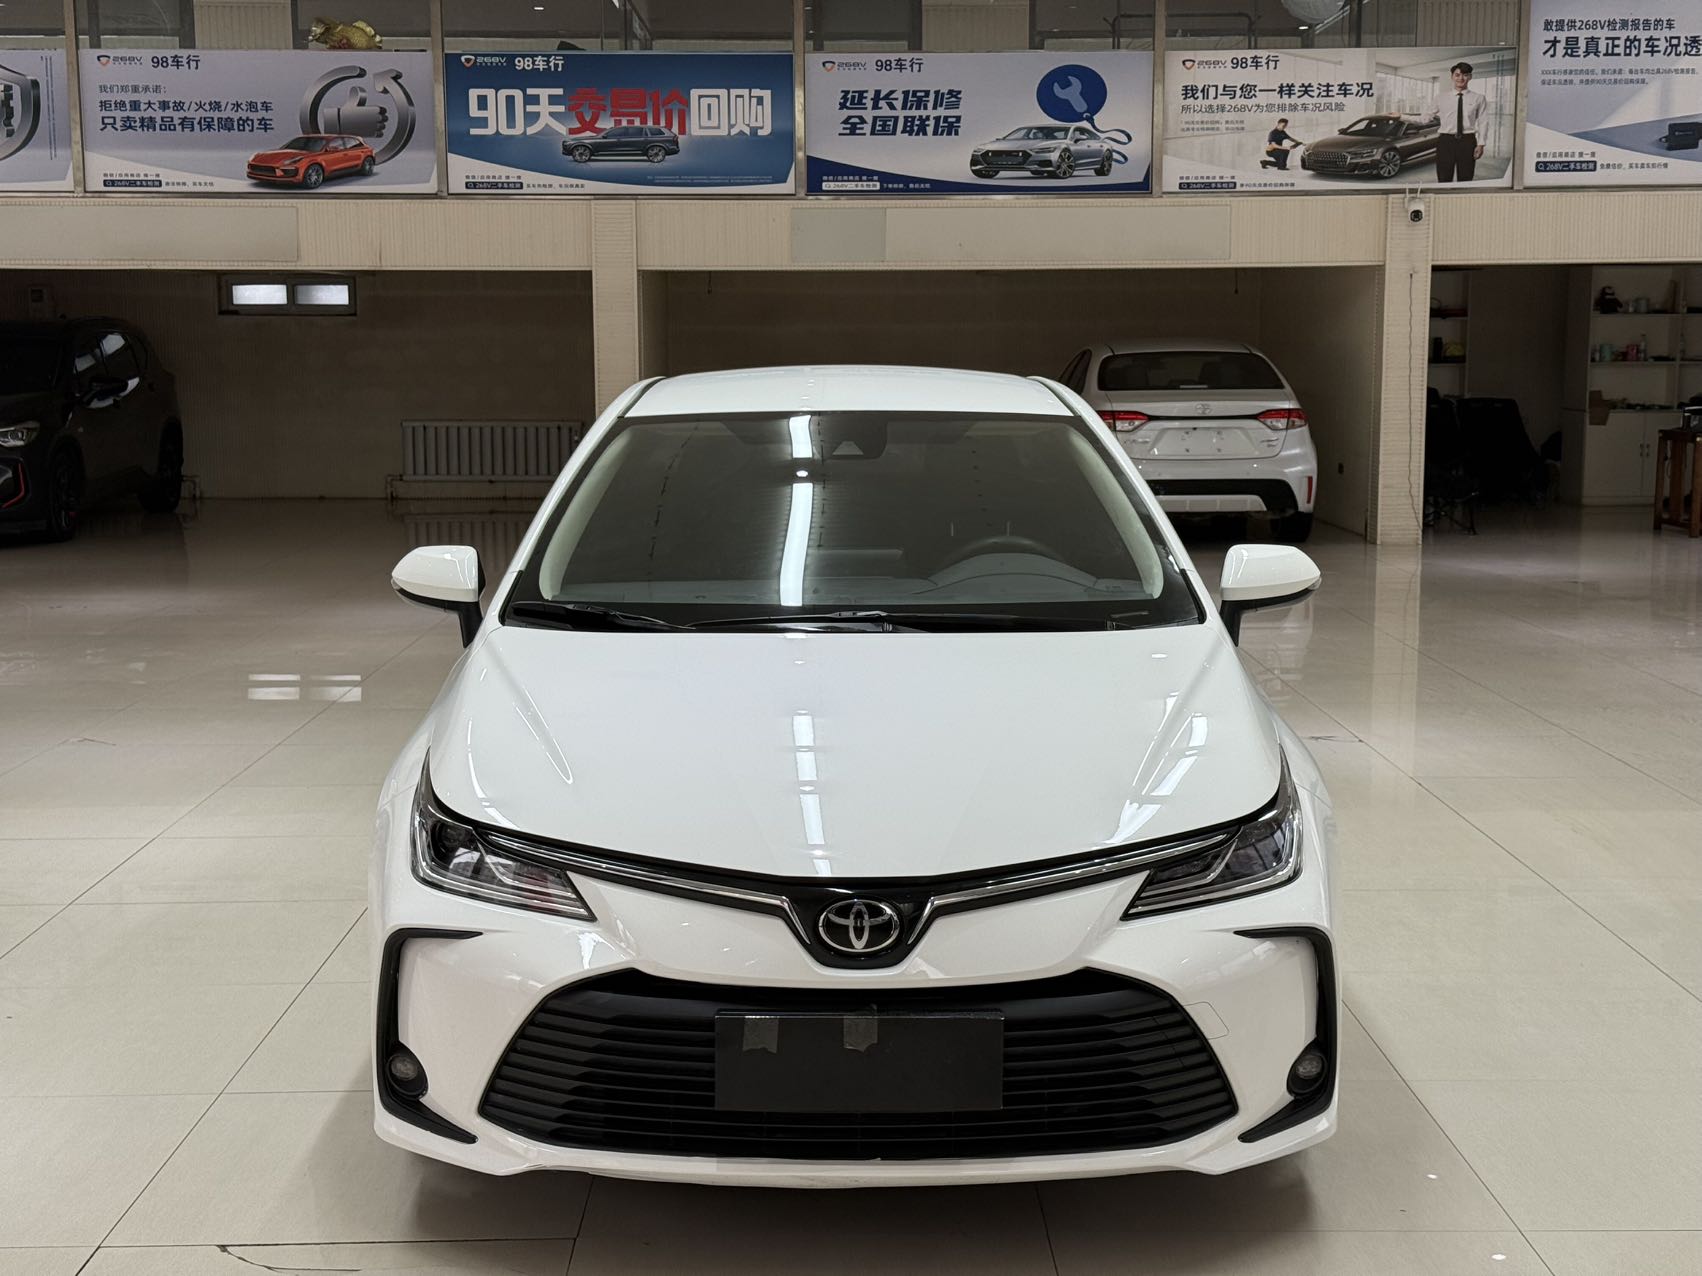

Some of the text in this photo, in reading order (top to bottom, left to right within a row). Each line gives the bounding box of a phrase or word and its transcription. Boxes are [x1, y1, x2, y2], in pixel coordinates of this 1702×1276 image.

[1543, 18, 1676, 32] 敢提供268V检测报告的车
[1542, 35, 1702, 58] 才是真正的车况透
[151, 54, 201, 70] 98车行
[515, 55, 565, 71] 98车行
[875, 57, 924, 73] 98车行
[1231, 55, 1280, 70] 98车行
[1181, 82, 1374, 100] 我们与您一样关注车况
[99, 100, 274, 113] 拒绝重大事故/火烧/水泡车
[838, 89, 962, 111] 延长保修
[1180, 102, 1346, 114] 所以选择268V为您排除车况风险
[468, 87, 772, 136] 90天交易价回购
[100, 116, 275, 133] 只卖精品有保障的车
[838, 115, 962, 136] 全国联保
